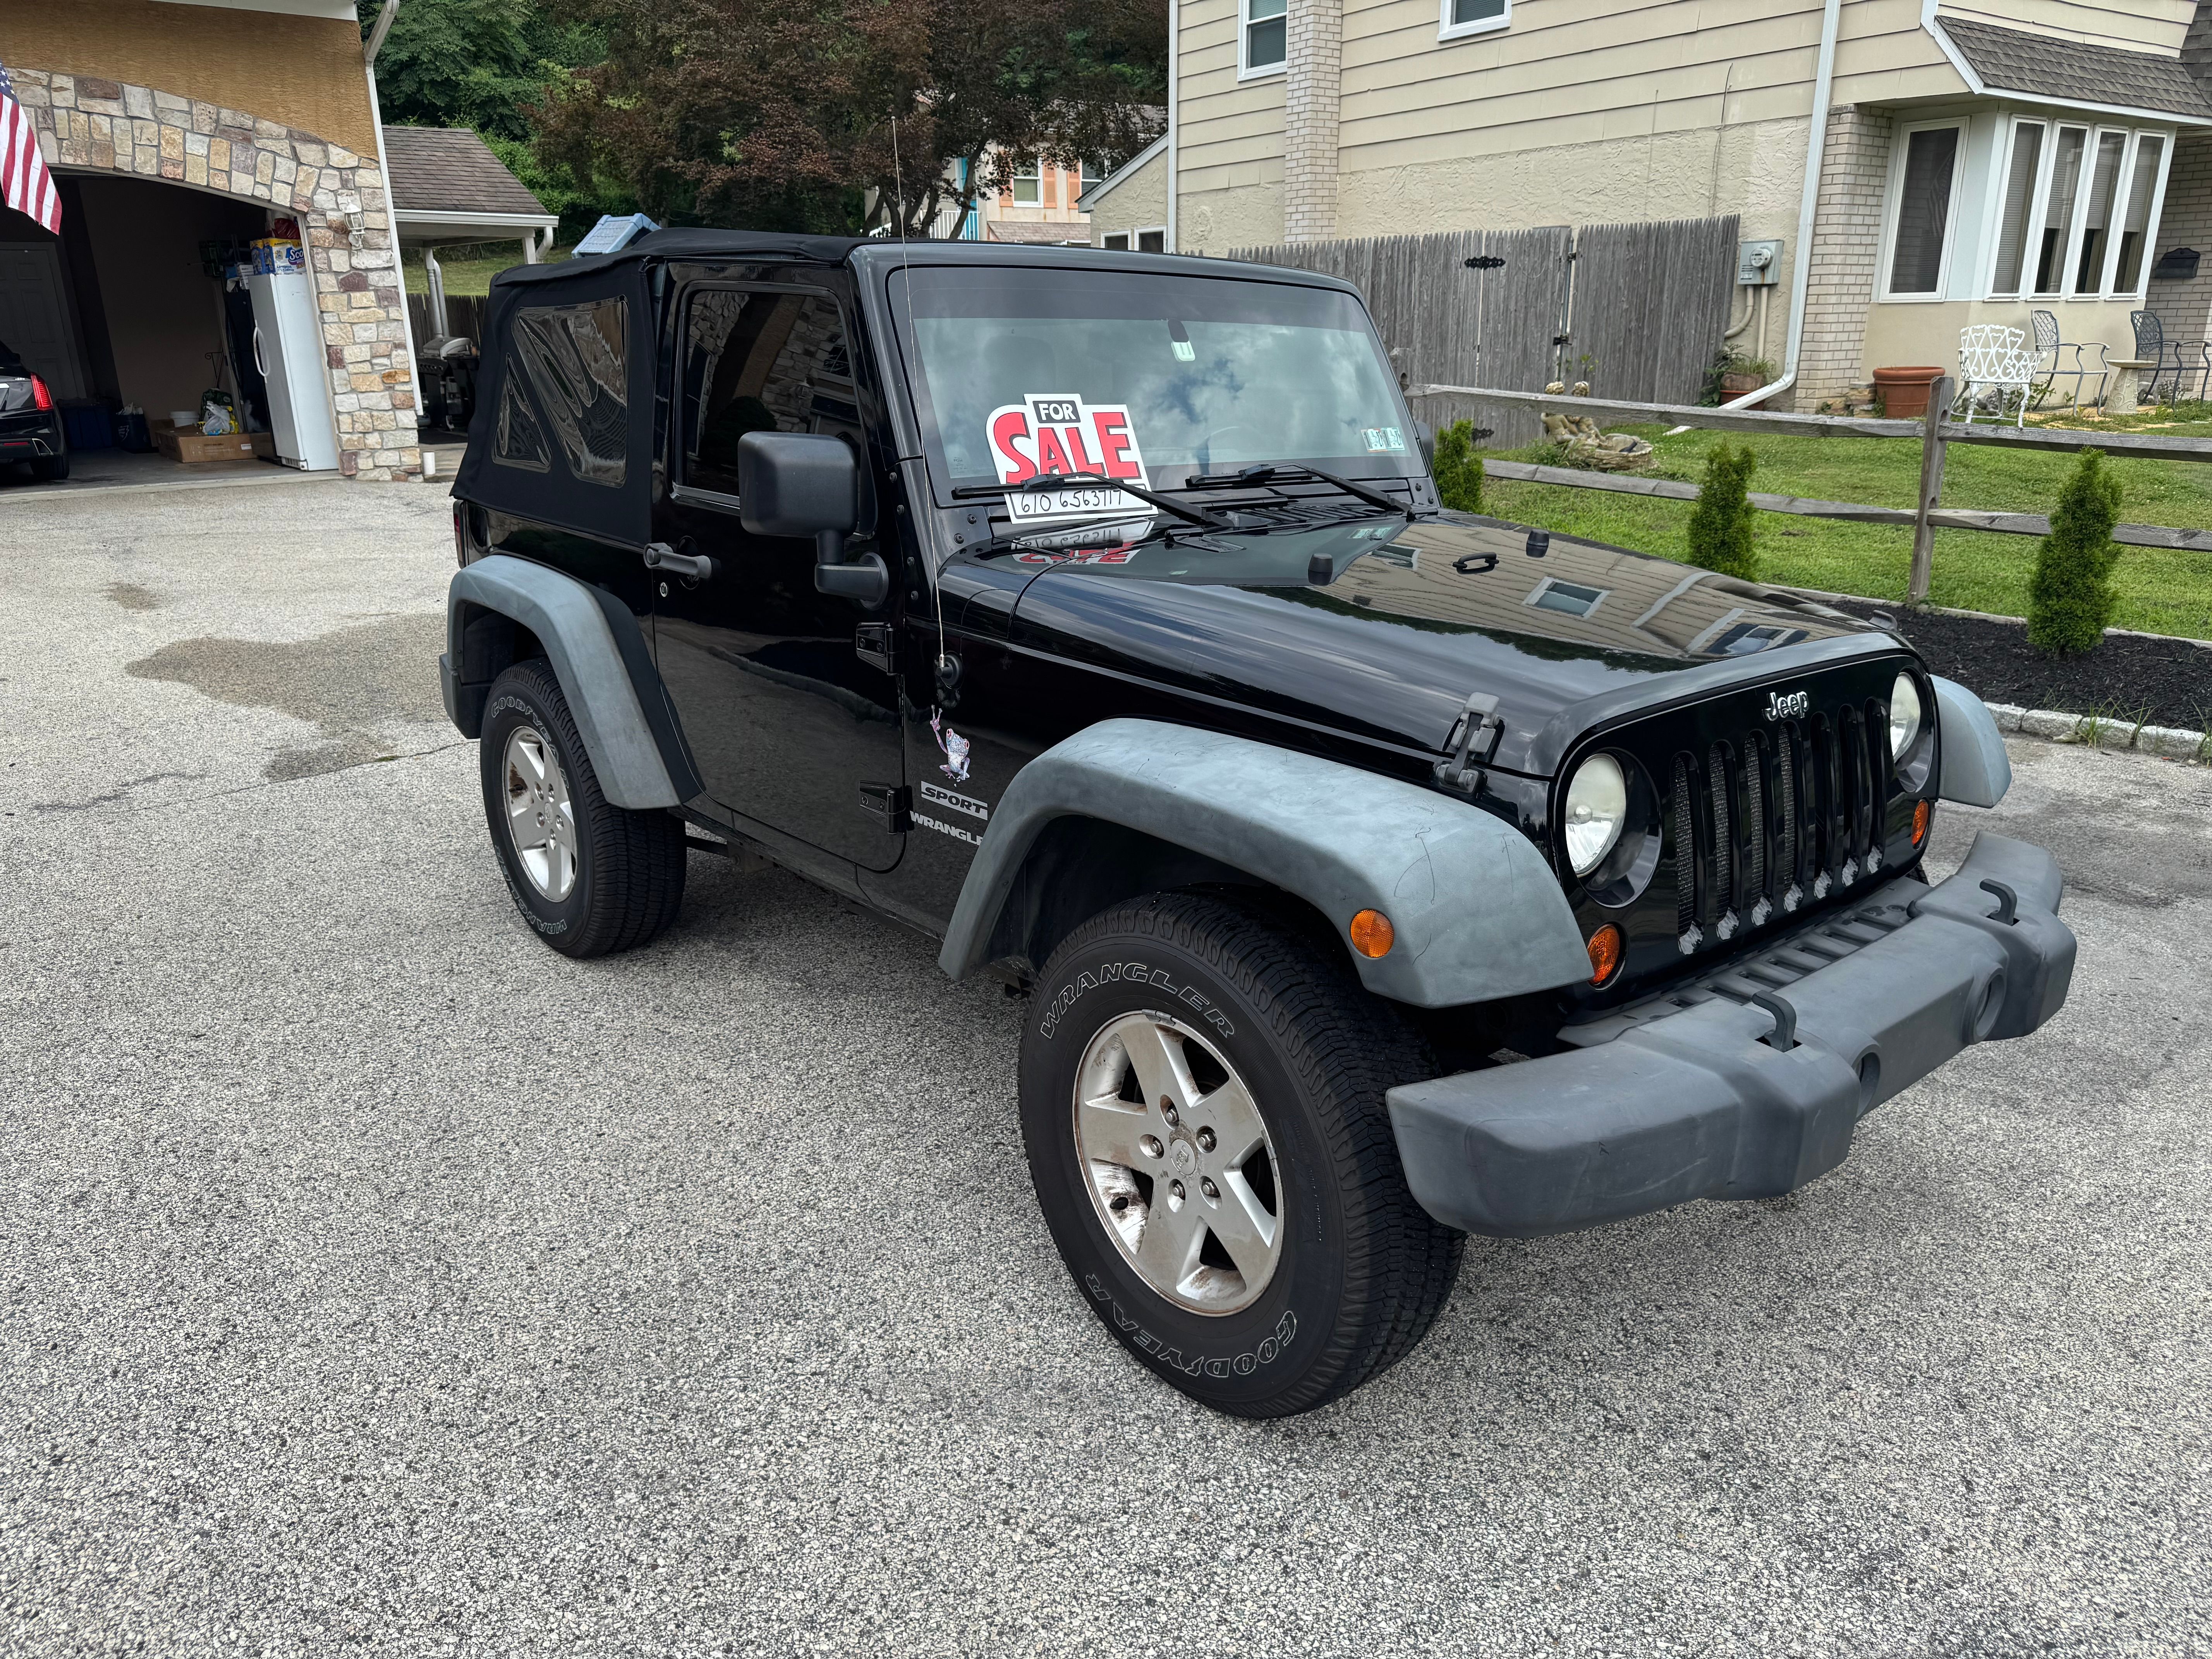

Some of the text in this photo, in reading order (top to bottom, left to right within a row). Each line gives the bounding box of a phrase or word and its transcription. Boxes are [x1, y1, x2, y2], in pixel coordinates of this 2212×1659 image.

[289, 249, 304, 261] Sco
[1038, 403, 1076, 421] FOR
[993, 412, 1142, 484] SALE
[1022, 489, 1121, 514] 610 6563717
[1762, 691, 1809, 721] Jeep
[491, 696, 569, 788] GOODYEAR
[922, 787, 988, 814] SPORT
[495, 845, 567, 934] WRANGLER
[1040, 962, 1235, 1039] WRANGLER
[1085, 1273, 1297, 1377] GOODYEAR
